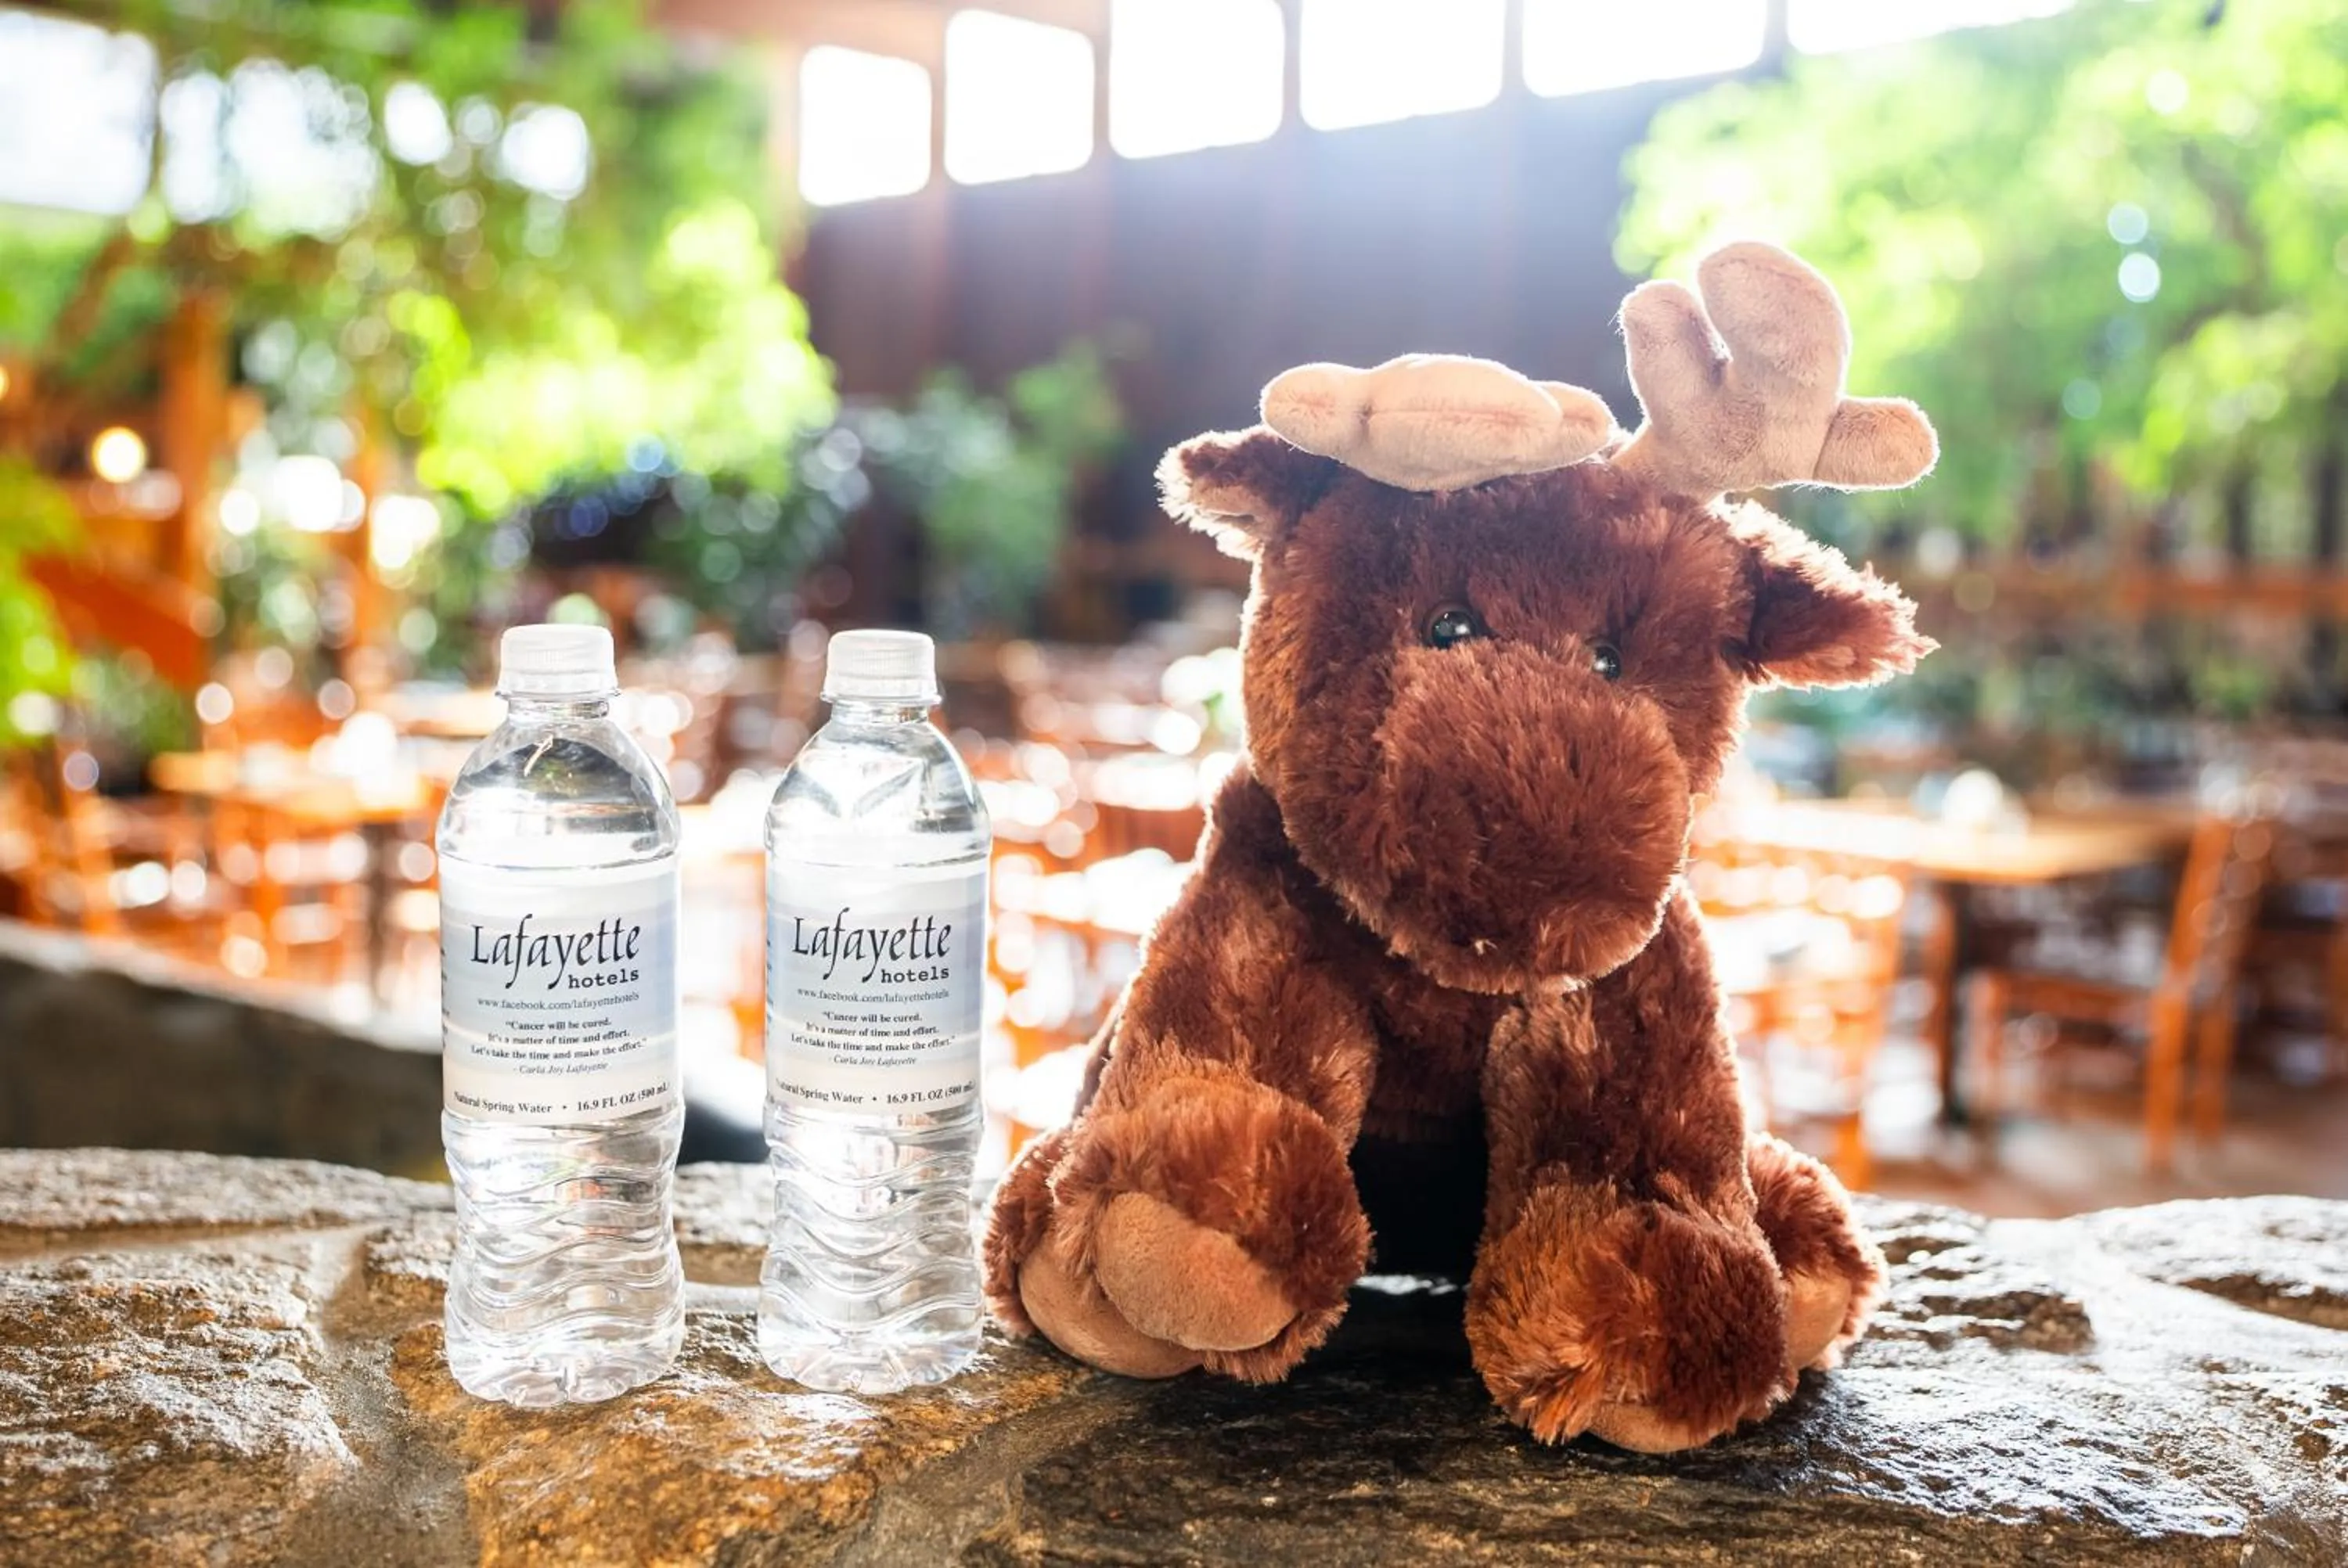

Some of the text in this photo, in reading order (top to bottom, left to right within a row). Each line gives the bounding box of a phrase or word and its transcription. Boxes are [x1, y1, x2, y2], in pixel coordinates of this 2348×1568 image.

[470, 913, 641, 990] Lafayette
[792, 908, 951, 983] Lafayette
[568, 969, 639, 989] hotels
[881, 966, 949, 983] hotels
[548, 1021, 565, 1030] will
[582, 1017, 611, 1029] cured.
[861, 1014, 877, 1023] will
[880, 1014, 891, 1023] be
[894, 1012, 922, 1023] cured.
[546, 1035, 556, 1045] of
[559, 1036, 579, 1045] time
[583, 1033, 600, 1042] and
[603, 1029, 630, 1040] effort.
[828, 1027, 856, 1036] matter
[859, 1028, 869, 1037] of
[870, 1028, 891, 1037] time
[893, 1027, 910, 1037] and
[913, 1026, 939, 1035] effort.
[492, 1049, 510, 1058] take
[529, 1051, 550, 1059] time
[553, 1050, 571, 1059] and
[574, 1048, 600, 1058] make
[603, 1046, 617, 1056] the
[809, 1038, 826, 1047] take
[827, 1041, 841, 1049] the
[843, 1041, 862, 1051] time
[885, 1042, 909, 1051] make
[912, 1041, 925, 1050] the
[566, 1062, 609, 1074] Lafayette
[481, 1099, 515, 1113] Spring
[517, 1102, 552, 1113] Water
[578, 1100, 599, 1112] 16.9
[619, 1092, 636, 1103] OZ
[800, 1087, 829, 1102] Spring
[831, 1091, 863, 1103] Water
[887, 1094, 907, 1104] 16.9
[928, 1088, 943, 1100] OZ
